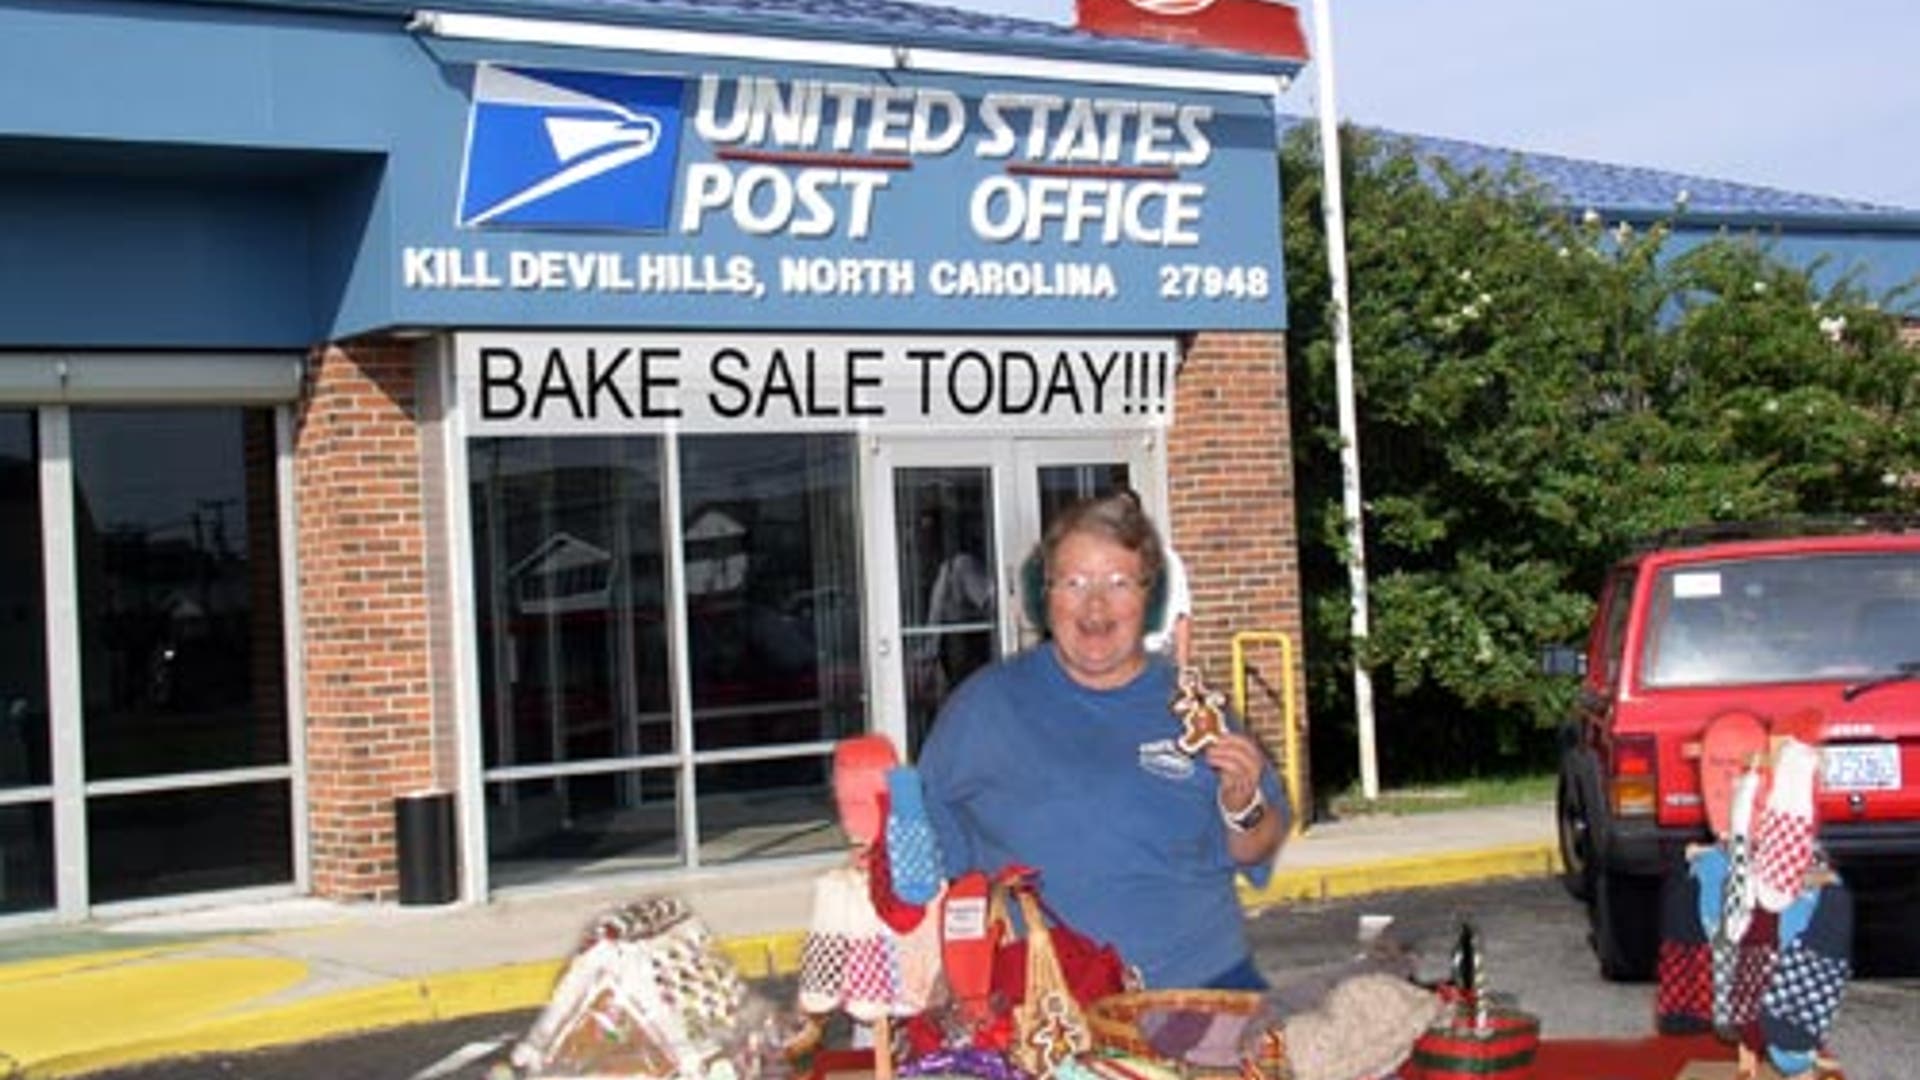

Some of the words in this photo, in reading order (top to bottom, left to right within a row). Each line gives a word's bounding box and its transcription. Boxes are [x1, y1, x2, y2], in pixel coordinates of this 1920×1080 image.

[696, 73, 966, 153] UNITED
[976, 93, 1212, 166] STATES
[681, 164, 888, 238] POST
[970, 176, 1205, 246] OFFICE
[402, 248, 500, 288] KILL
[510, 251, 633, 289] DEVIL
[638, 254, 765, 297] HILLS,
[780, 258, 915, 296] NORTH
[929, 262, 1117, 298] CAROLINA
[1159, 264, 1269, 297] 27948
[479, 347, 682, 419] BAKE
[708, 348, 885, 418] SALE
[906, 350, 1167, 415] TODAY!!!
